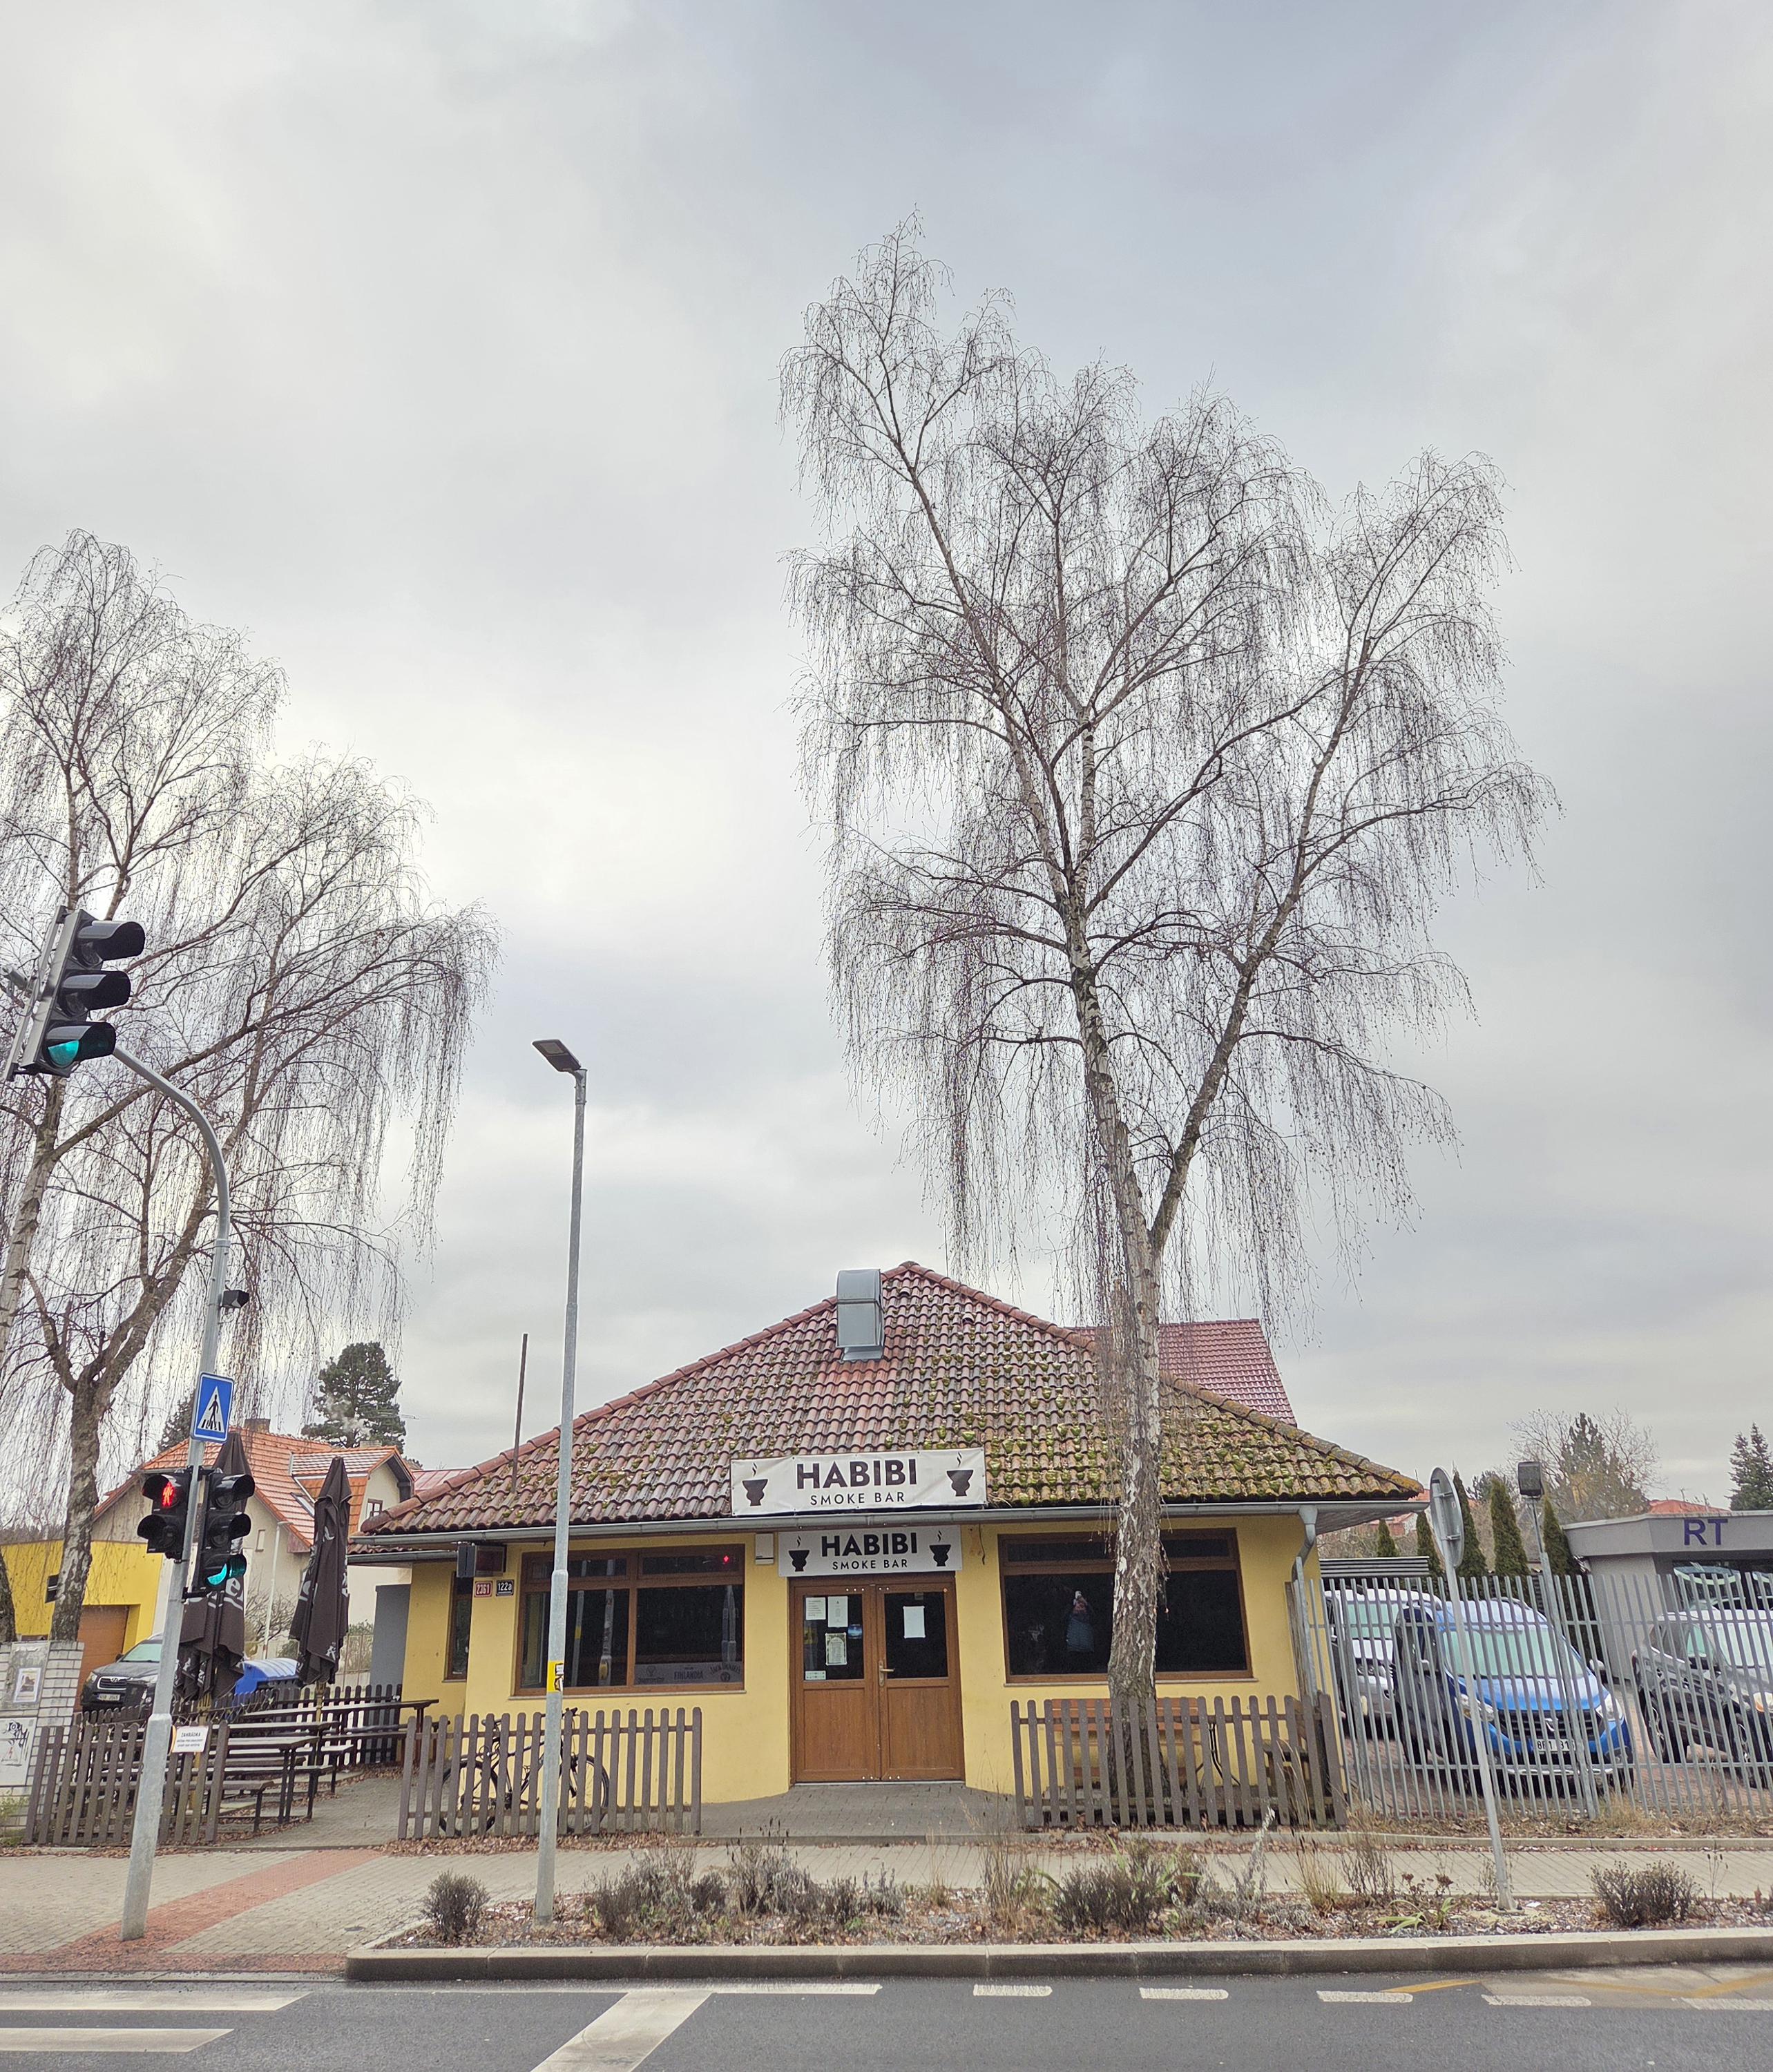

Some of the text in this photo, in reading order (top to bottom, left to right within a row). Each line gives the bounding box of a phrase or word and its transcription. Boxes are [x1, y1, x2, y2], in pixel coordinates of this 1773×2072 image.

[797, 1459, 917, 1489] HABIBI
[810, 1492, 905, 1506] SMOKE BAR
[1683, 1518, 1729, 1546] RT
[821, 1533, 917, 1557] HABIBI
[832, 1560, 908, 1570] SMOKE BAR
[498, 1582, 512, 1591] 122a
